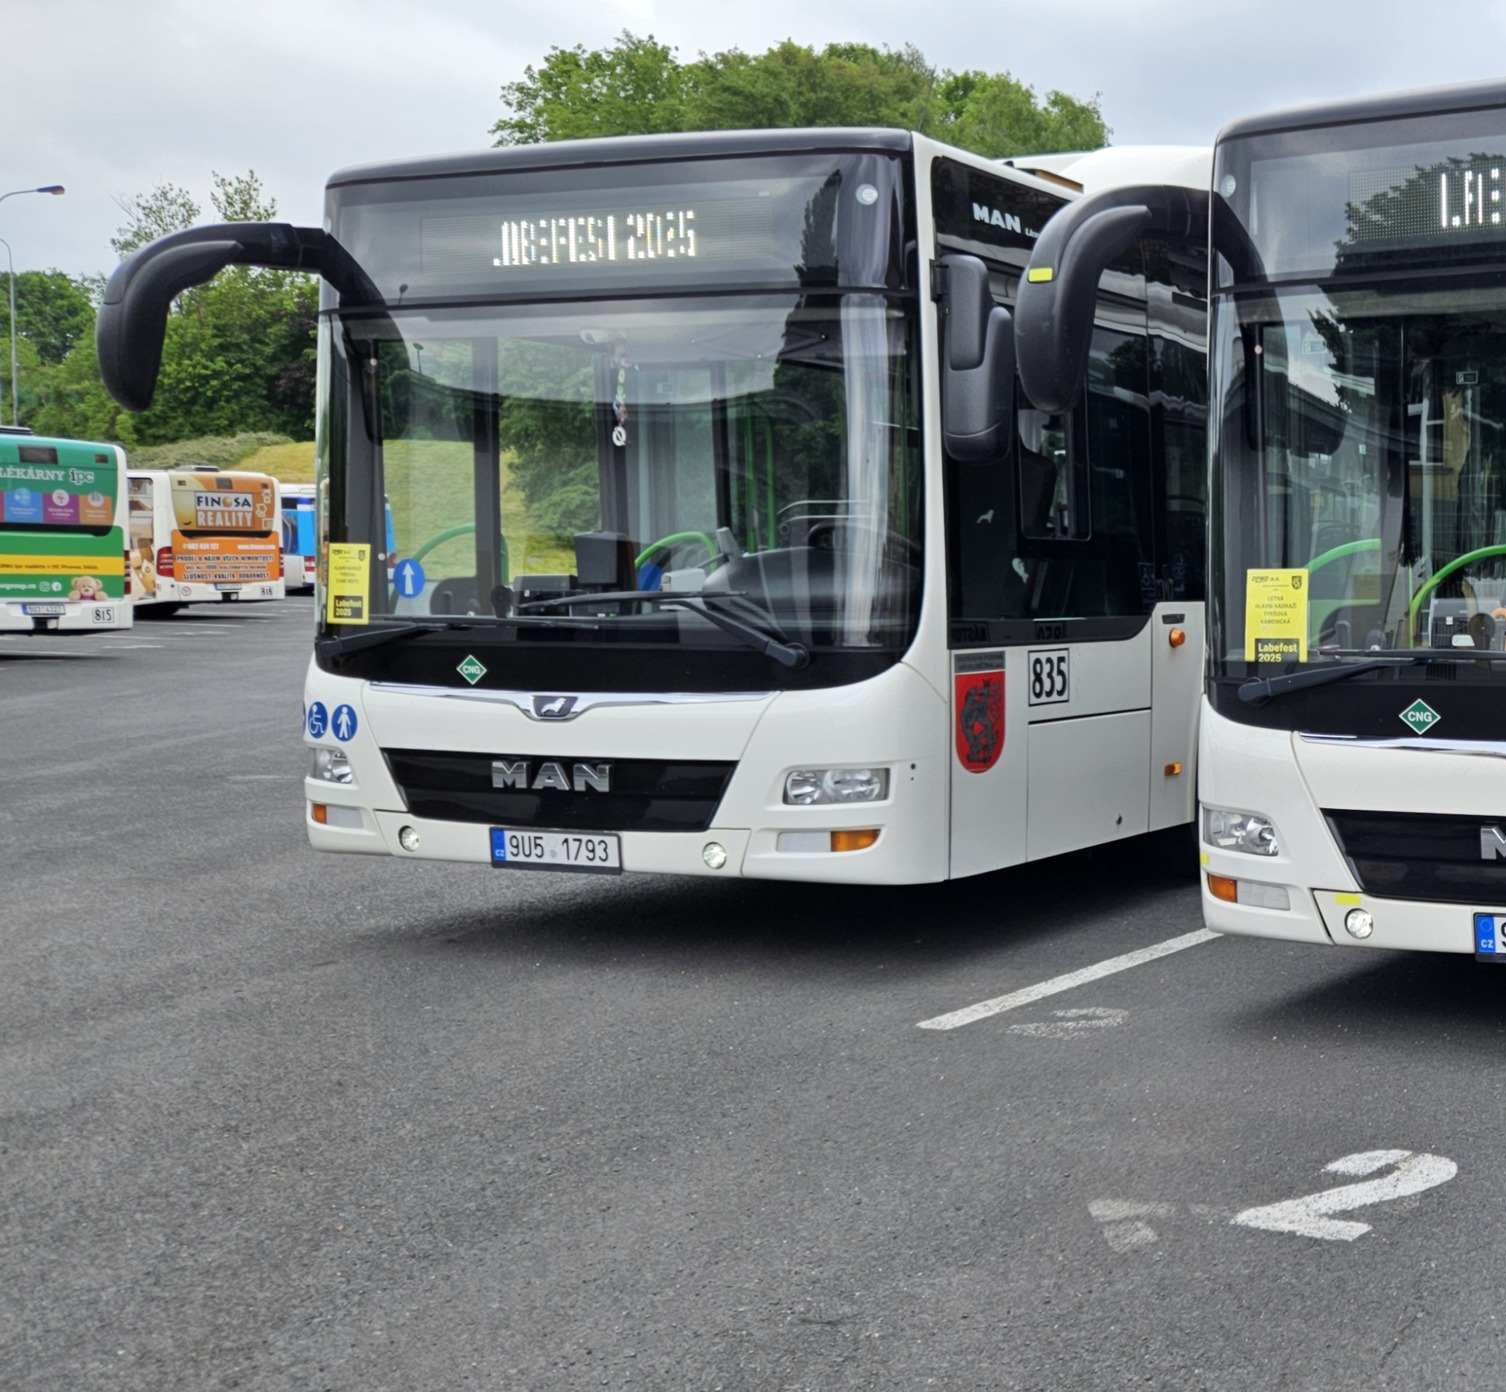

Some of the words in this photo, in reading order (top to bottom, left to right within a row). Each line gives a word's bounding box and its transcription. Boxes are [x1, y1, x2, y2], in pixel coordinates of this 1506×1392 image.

[972, 202, 1022, 234] MAN
[0, 465, 65, 481] LÉKÁRNY
[69, 468, 95, 485] ipc
[197, 511, 253, 527] REALITY
[335, 599, 362, 608] Labefest
[94, 609, 112, 621] 815
[335, 608, 352, 616] 2025
[1258, 642, 1298, 653] Labefest
[1258, 653, 1282, 663] 2025
[462, 665, 481, 675] CNG
[1032, 656, 1067, 699] 835
[1407, 711, 1433, 722] CNG
[492, 761, 612, 792] MAN
[495, 848, 506, 858] CZ
[509, 834, 545, 859] 9U5
[561, 837, 609, 863] 1793
[1480, 938, 1495, 949] CZ
[1230, 1148, 1458, 1241] 2
